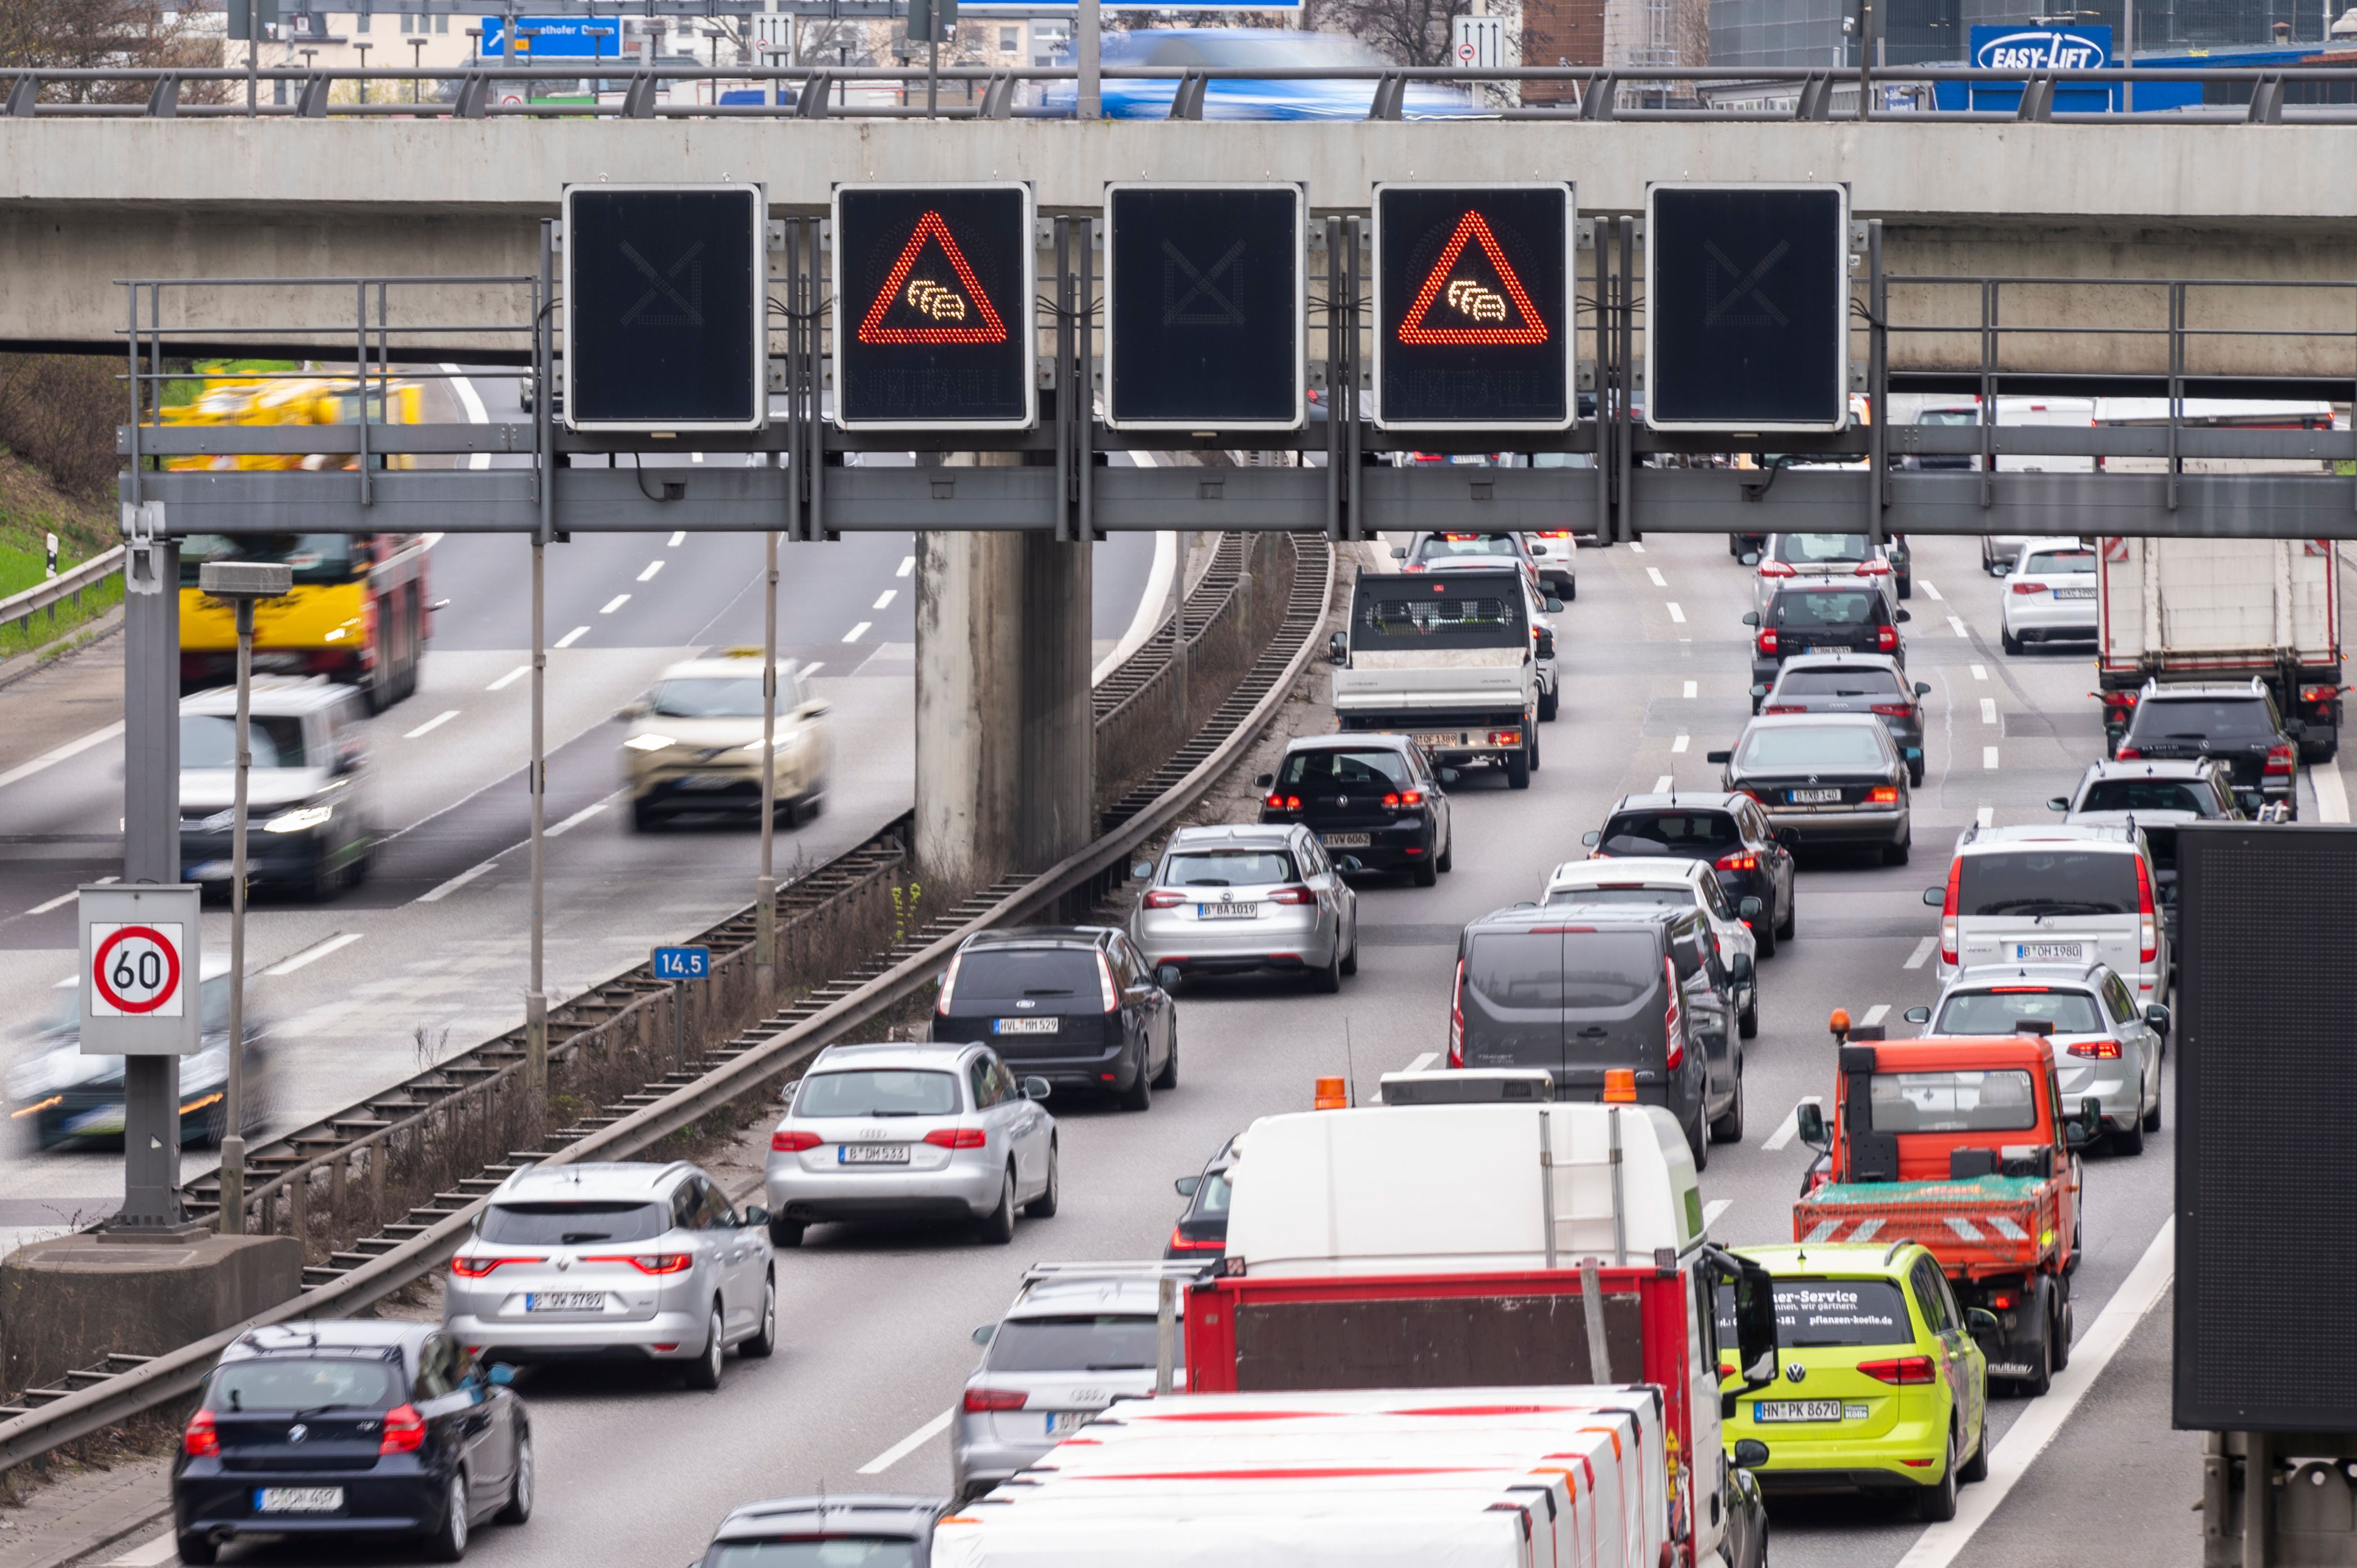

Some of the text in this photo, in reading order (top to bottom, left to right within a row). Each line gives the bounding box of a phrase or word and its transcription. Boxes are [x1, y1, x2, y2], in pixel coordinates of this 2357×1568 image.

[1992, 34, 2092, 68] EASY-LIFT
[1436, 734, 1456, 743] 1389
[1796, 790, 1802, 801] B
[1822, 789, 1837, 801] 140
[1323, 834, 1369, 844] B VW 6062
[1204, 904, 1255, 914] B BA 1019
[2024, 947, 2079, 957] B OH 1980
[662, 953, 702, 974] 14.5
[113, 950, 161, 989] 60
[1001, 1020, 1018, 1030] HVL
[1040, 1020, 1057, 1029] 529
[850, 1148, 856, 1160] B
[882, 1148, 904, 1160] 533
[1809, 1315, 1893, 1326] pflanzen-koelle.de
[1763, 1402, 1839, 1417] HN PK 8670
